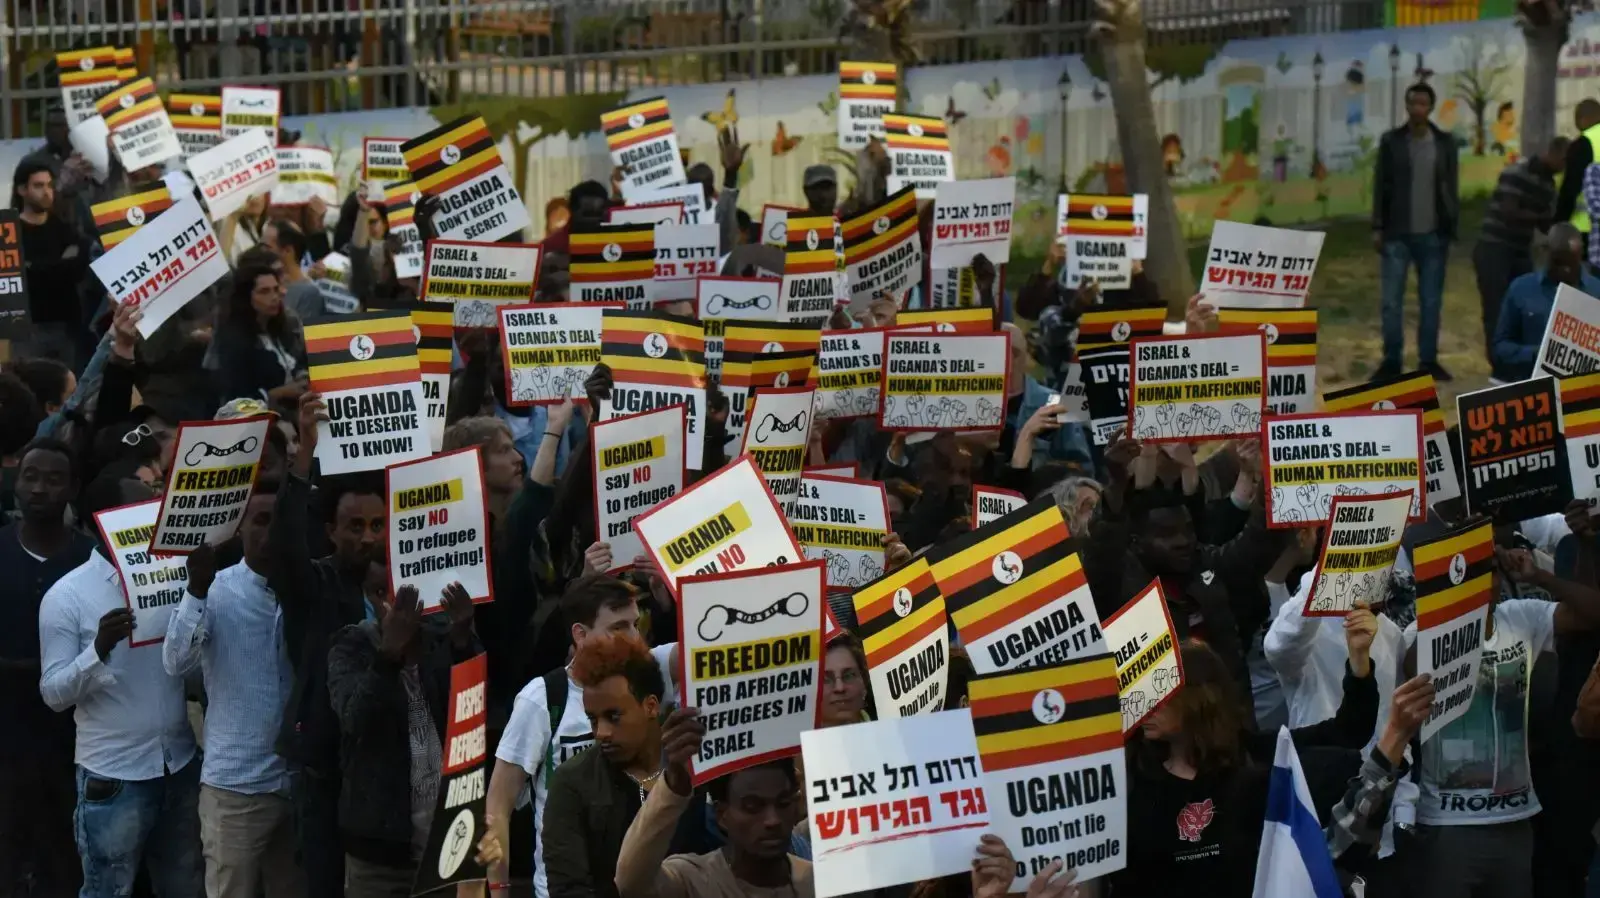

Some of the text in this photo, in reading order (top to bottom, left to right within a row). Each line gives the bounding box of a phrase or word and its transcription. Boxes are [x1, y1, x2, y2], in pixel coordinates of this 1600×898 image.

[225, 113, 273, 125] FREEDOM
[620, 139, 672, 165] UGANDA
[896, 152, 946, 166] UGANDA
[204, 158, 276, 198] נגד הגירוש
[441, 175, 504, 214] UGANDA
[438, 188, 518, 234] DON'T KEEP IT A
[936, 202, 1012, 220] דרום תל אביב
[464, 212, 508, 240] SECRET!
[936, 220, 1010, 239] נגד הגירוש
[110, 218, 206, 295] דרום תל אביב
[433, 248, 478, 262] ISRAEL &
[678, 246, 716, 259] דרום
[858, 242, 914, 278] UGANDA
[1076, 240, 1126, 257] UGANDA
[1210, 248, 1314, 271] דרום תל אביב
[120, 234, 216, 306] נגד הגירוש
[431, 264, 508, 280] UGANDA'S DEAL
[684, 261, 716, 274] נגד
[852, 279, 880, 294] DON'T
[883, 264, 904, 283] KEEP
[1208, 266, 1310, 290] נגד הגירוש
[428, 281, 530, 296] HUMAN TRAFFICKING
[581, 284, 645, 302] UGANDA
[790, 277, 834, 298] UGANDA
[787, 300, 799, 312] WE
[506, 312, 558, 326] ISRAEL &
[508, 330, 596, 346] UGANDA'S DEAL
[821, 339, 860, 352] RAEL &
[891, 340, 942, 354] ISRAEL &
[511, 350, 554, 364] HUMAN
[820, 354, 870, 370] GANDA'S
[1138, 345, 1190, 361] ISRAEL &
[890, 360, 975, 374] UGANDA'S DEAL
[1138, 364, 1198, 381] UGANDA'S
[1200, 362, 1229, 378] DEAL
[888, 378, 1003, 392] HUMAN TRAFFICKING
[1138, 380, 1261, 402] HUMAN TRAFFICKING
[327, 389, 417, 420] UGANDA
[427, 404, 445, 418] IT A
[1467, 392, 1550, 431] גירוש
[328, 413, 419, 438] WE DESERVE
[1271, 423, 1332, 440] ISRAEL &
[340, 436, 413, 459] TO KNOW!
[1470, 422, 1553, 457] הוא לא
[604, 440, 653, 468] UGANDA
[1272, 442, 1380, 462] UGANDA'S DEAL
[174, 466, 254, 491] FREEDOM
[605, 464, 650, 491] say NO
[1273, 461, 1418, 483] HUMAN TRAFFICKING
[1472, 449, 1556, 489] הפיתרון
[170, 489, 248, 509] FOR AFRICAN
[399, 483, 450, 510] UGANDA
[606, 484, 676, 514] to refugee
[812, 486, 820, 500] &
[830, 507, 856, 524] DEAL
[979, 496, 1006, 515] ISRAEL
[1336, 506, 1374, 523] ISRAEL &
[166, 508, 241, 528] REFUGEES IN
[398, 508, 448, 532] say NO
[398, 528, 476, 555] to refugee
[665, 513, 736, 565] UGANDA
[816, 528, 887, 548] TRAFFICKING
[1330, 526, 1390, 546] UGANDA'S DEAL
[125, 551, 152, 566] say
[400, 546, 484, 579] trafficking!
[716, 544, 746, 572] NO
[1324, 552, 1360, 570] HUMAN
[132, 566, 188, 588] to refug
[986, 600, 1086, 668] UGANDA
[1071, 628, 1088, 653] IT
[1090, 622, 1102, 644] A
[1432, 618, 1482, 670] UGANDA
[695, 634, 810, 679] FREEDOM
[1114, 636, 1141, 669] DEAL
[886, 638, 944, 700] UGANDA
[1460, 662, 1472, 680] lie
[696, 668, 812, 708] FOR AFRICAN
[900, 688, 929, 718] Don'nt
[928, 682, 940, 701] lie
[1445, 684, 1473, 716] people
[698, 694, 806, 732] REFUGEES IN
[698, 730, 755, 763] ISRAEL
[812, 756, 978, 804] דרום תל אביב
[1006, 764, 1116, 818] UGANDA
[815, 787, 987, 840] נגד הגירוש
[1020, 814, 1106, 848] Don'nt lie
[1066, 838, 1120, 871] people
